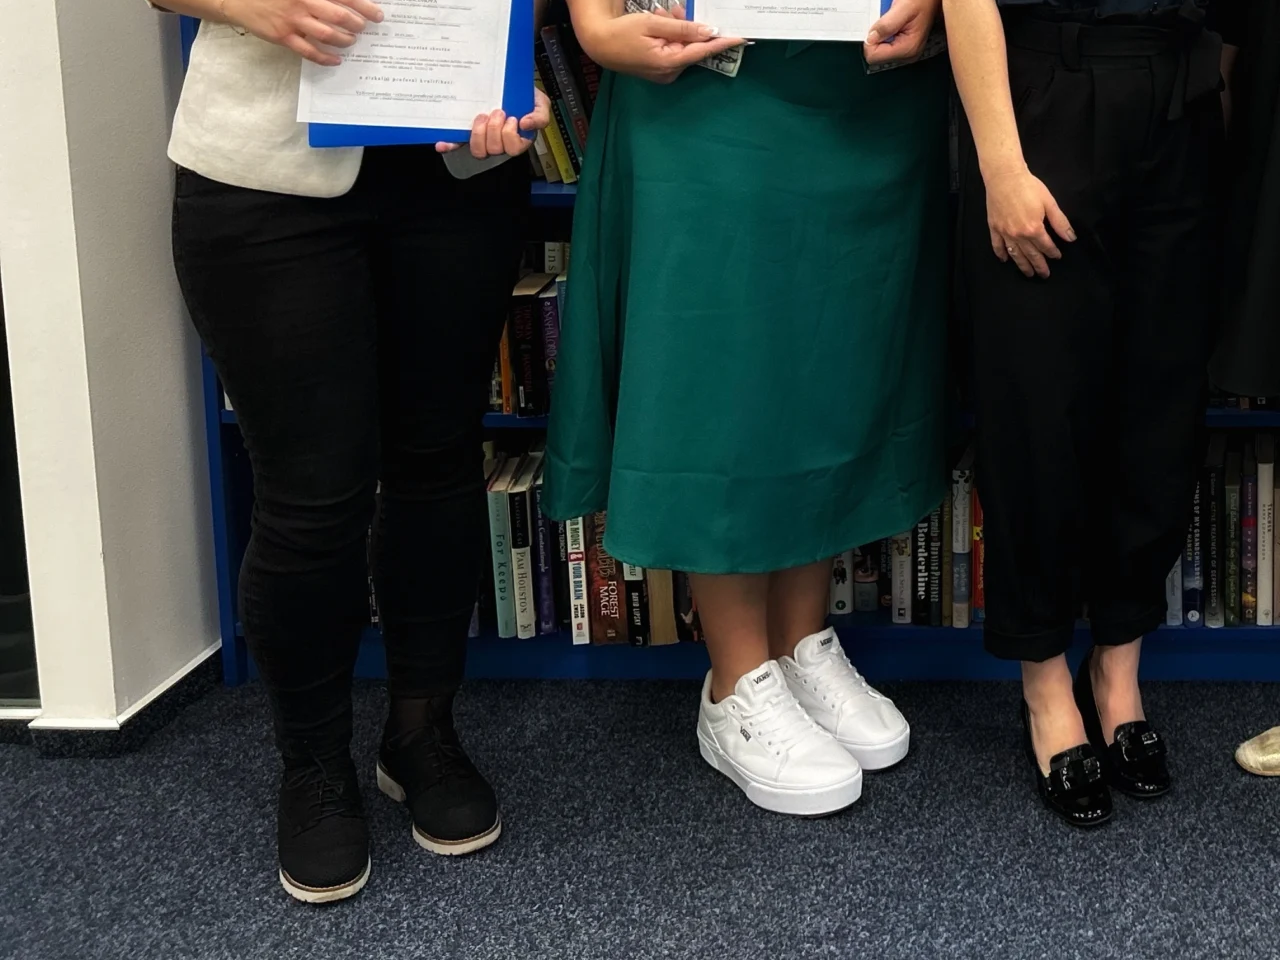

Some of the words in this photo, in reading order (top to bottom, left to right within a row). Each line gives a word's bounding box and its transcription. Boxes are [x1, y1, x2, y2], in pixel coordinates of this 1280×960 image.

[549, 37, 570, 85] TWISTED
[565, 87, 580, 116] TREE
[495, 534, 505, 555] For
[570, 527, 580, 550] MONEY
[1186, 534, 1194, 562] HANSEN
[1210, 524, 1218, 559] TREATMENT
[516, 552, 526, 570] PAM
[572, 562, 581, 579] YOUR
[916, 522, 929, 600] Borderline
[1192, 528, 1202, 587] GRANDCHILDREN
[499, 561, 508, 601] Keeps
[517, 572, 529, 614] HOUSTON
[573, 581, 583, 600] BRAIN
[1210, 569, 1218, 608] DEPRESSION
[599, 586, 610, 616] MAGE
[607, 580, 620, 619] FOREST
[632, 608, 641, 626] LIPSKY
[820, 636, 834, 647] VANS
[753, 672, 772, 685] VANS
[740, 724, 752, 743] VANS
